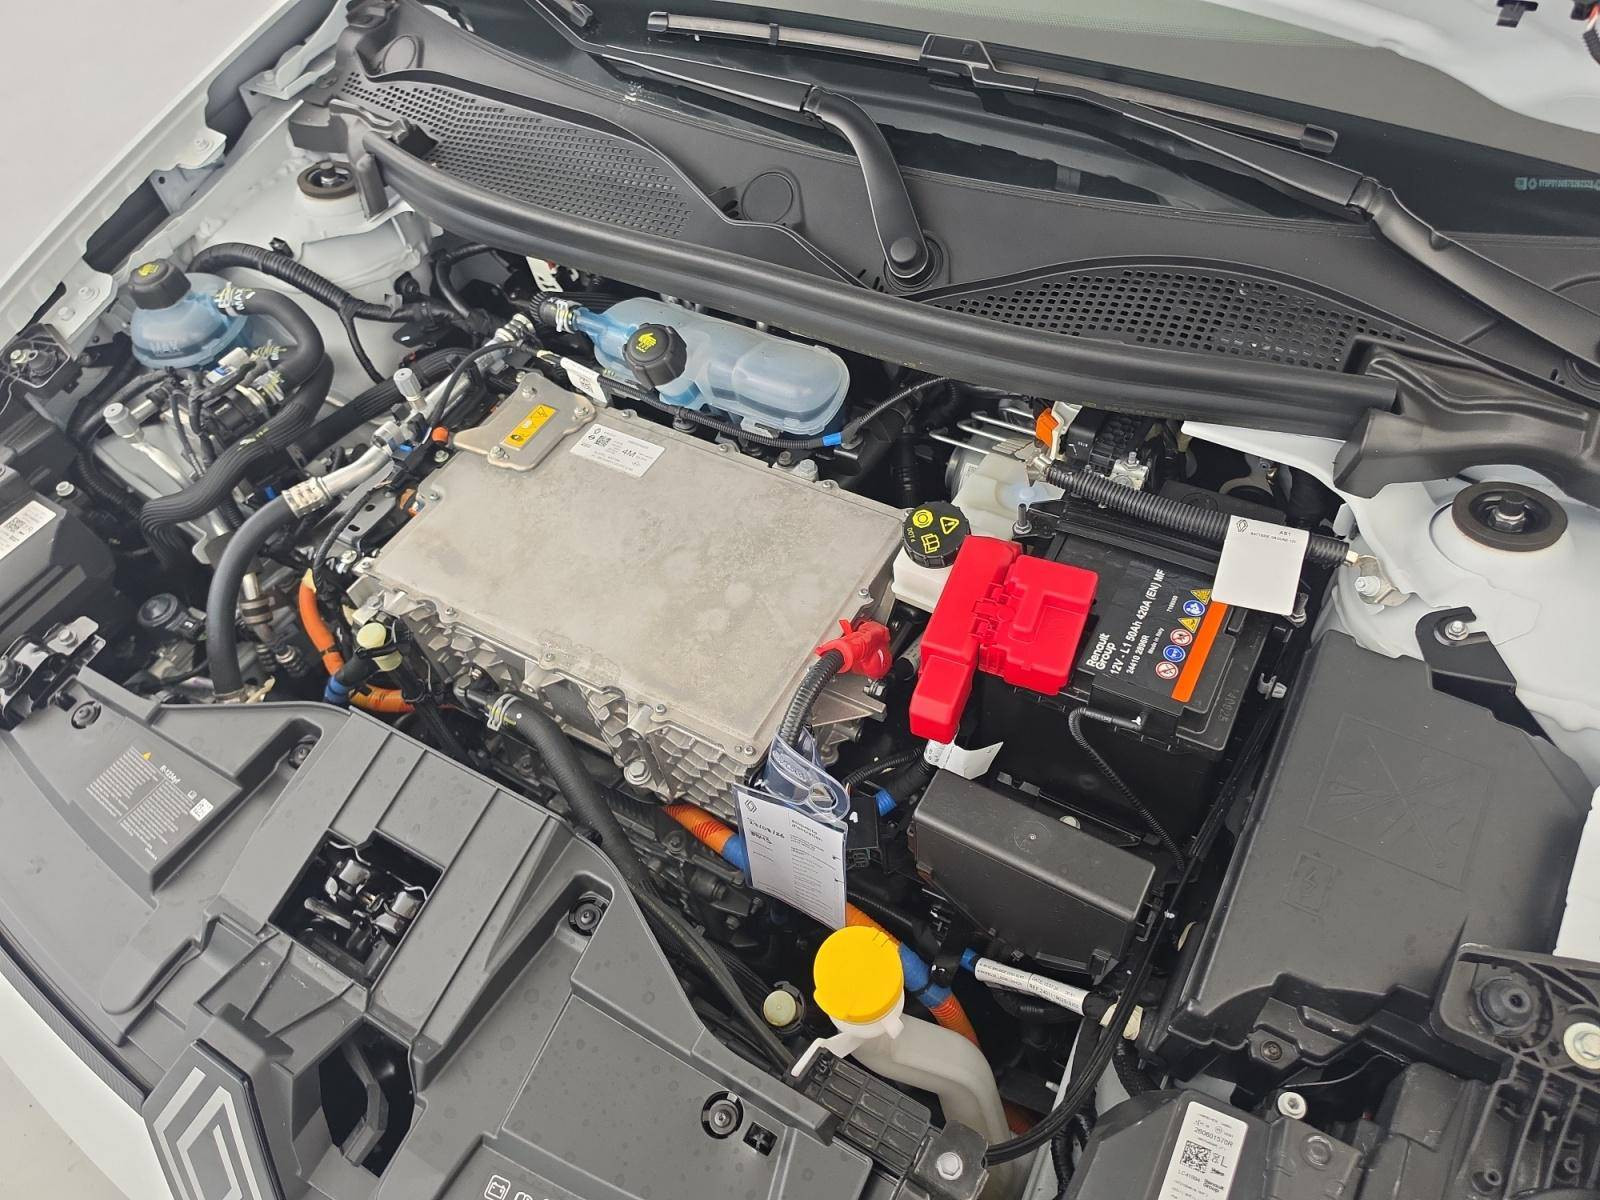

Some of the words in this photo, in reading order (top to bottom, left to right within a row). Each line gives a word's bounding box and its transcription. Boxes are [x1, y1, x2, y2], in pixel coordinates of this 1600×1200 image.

[907, 527, 915, 538] DOT
[1153, 568, 1166, 582] MF
[1144, 581, 1162, 601] (EN)
[1136, 600, 1152, 620] 420A
[1125, 620, 1143, 642] 50Ah
[1147, 641, 1158, 654] Made
[1155, 627, 1165, 638] Italy
[1085, 632, 1110, 668] Renault
[1094, 642, 1117, 671] Group
[1120, 642, 1132, 654] L1
[1109, 658, 1124, 675] 12V
[1125, 655, 1140, 675] 24410
